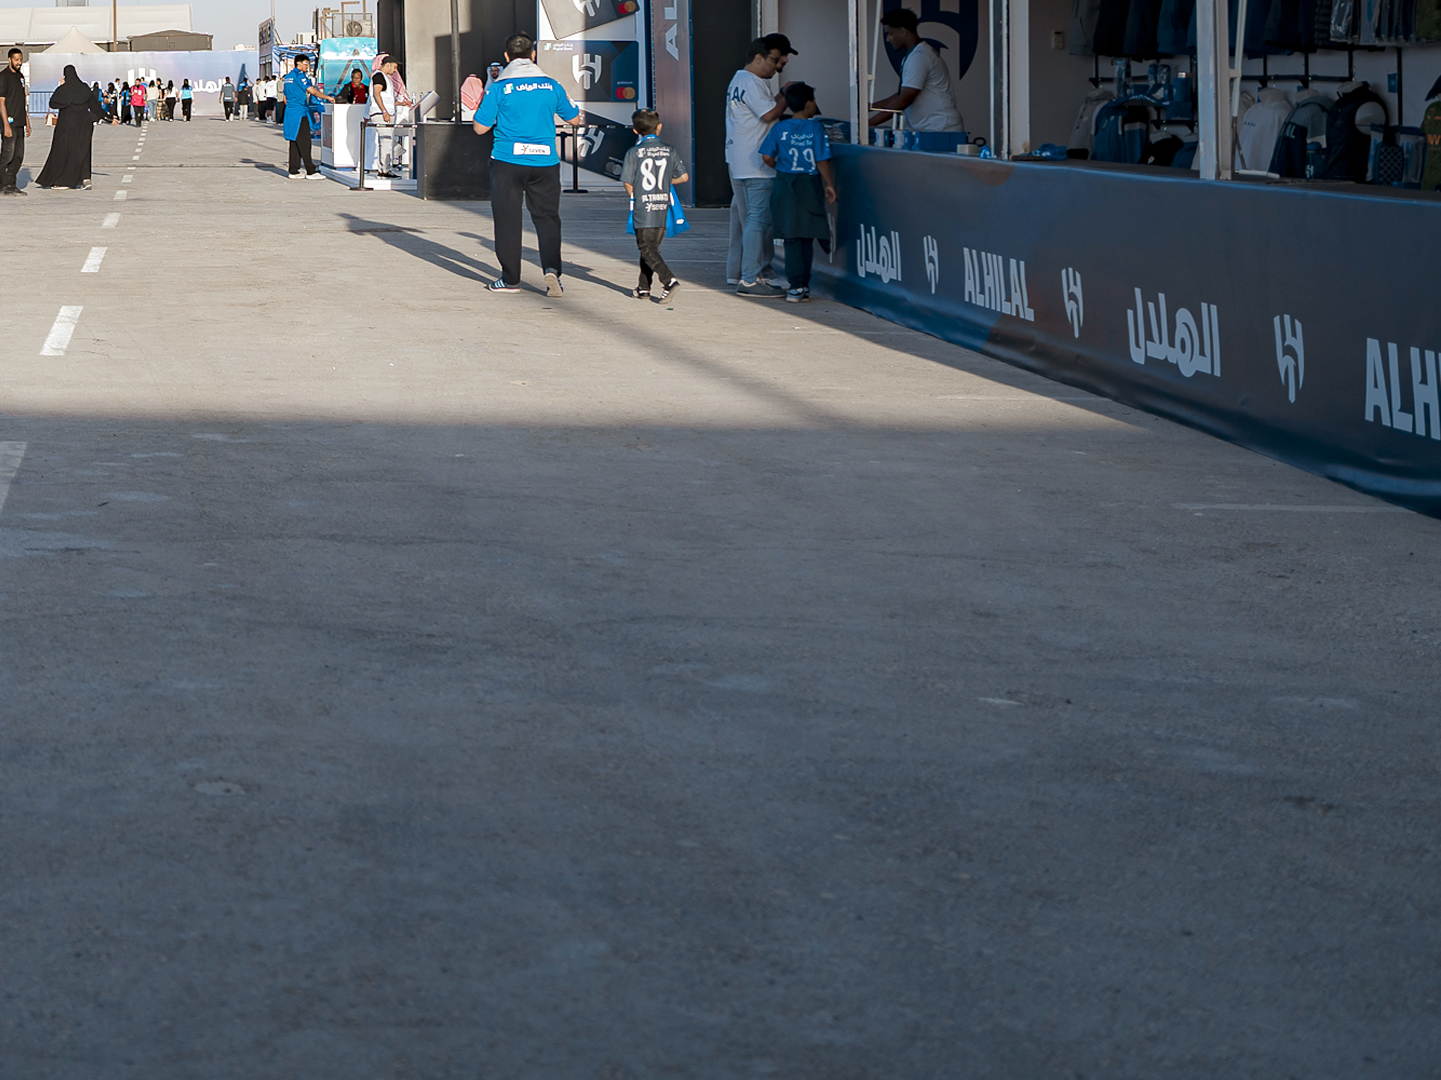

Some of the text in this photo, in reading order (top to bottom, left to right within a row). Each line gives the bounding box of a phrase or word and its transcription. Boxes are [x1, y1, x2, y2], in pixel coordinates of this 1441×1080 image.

[640, 157, 667, 191] 87
[788, 147, 816, 172] 29
[856, 223, 902, 284] الهلال
[962, 247, 1035, 322] ALHILAL
[1126, 286, 1221, 378] الهلال
[1365, 337, 1441, 441] ALH
